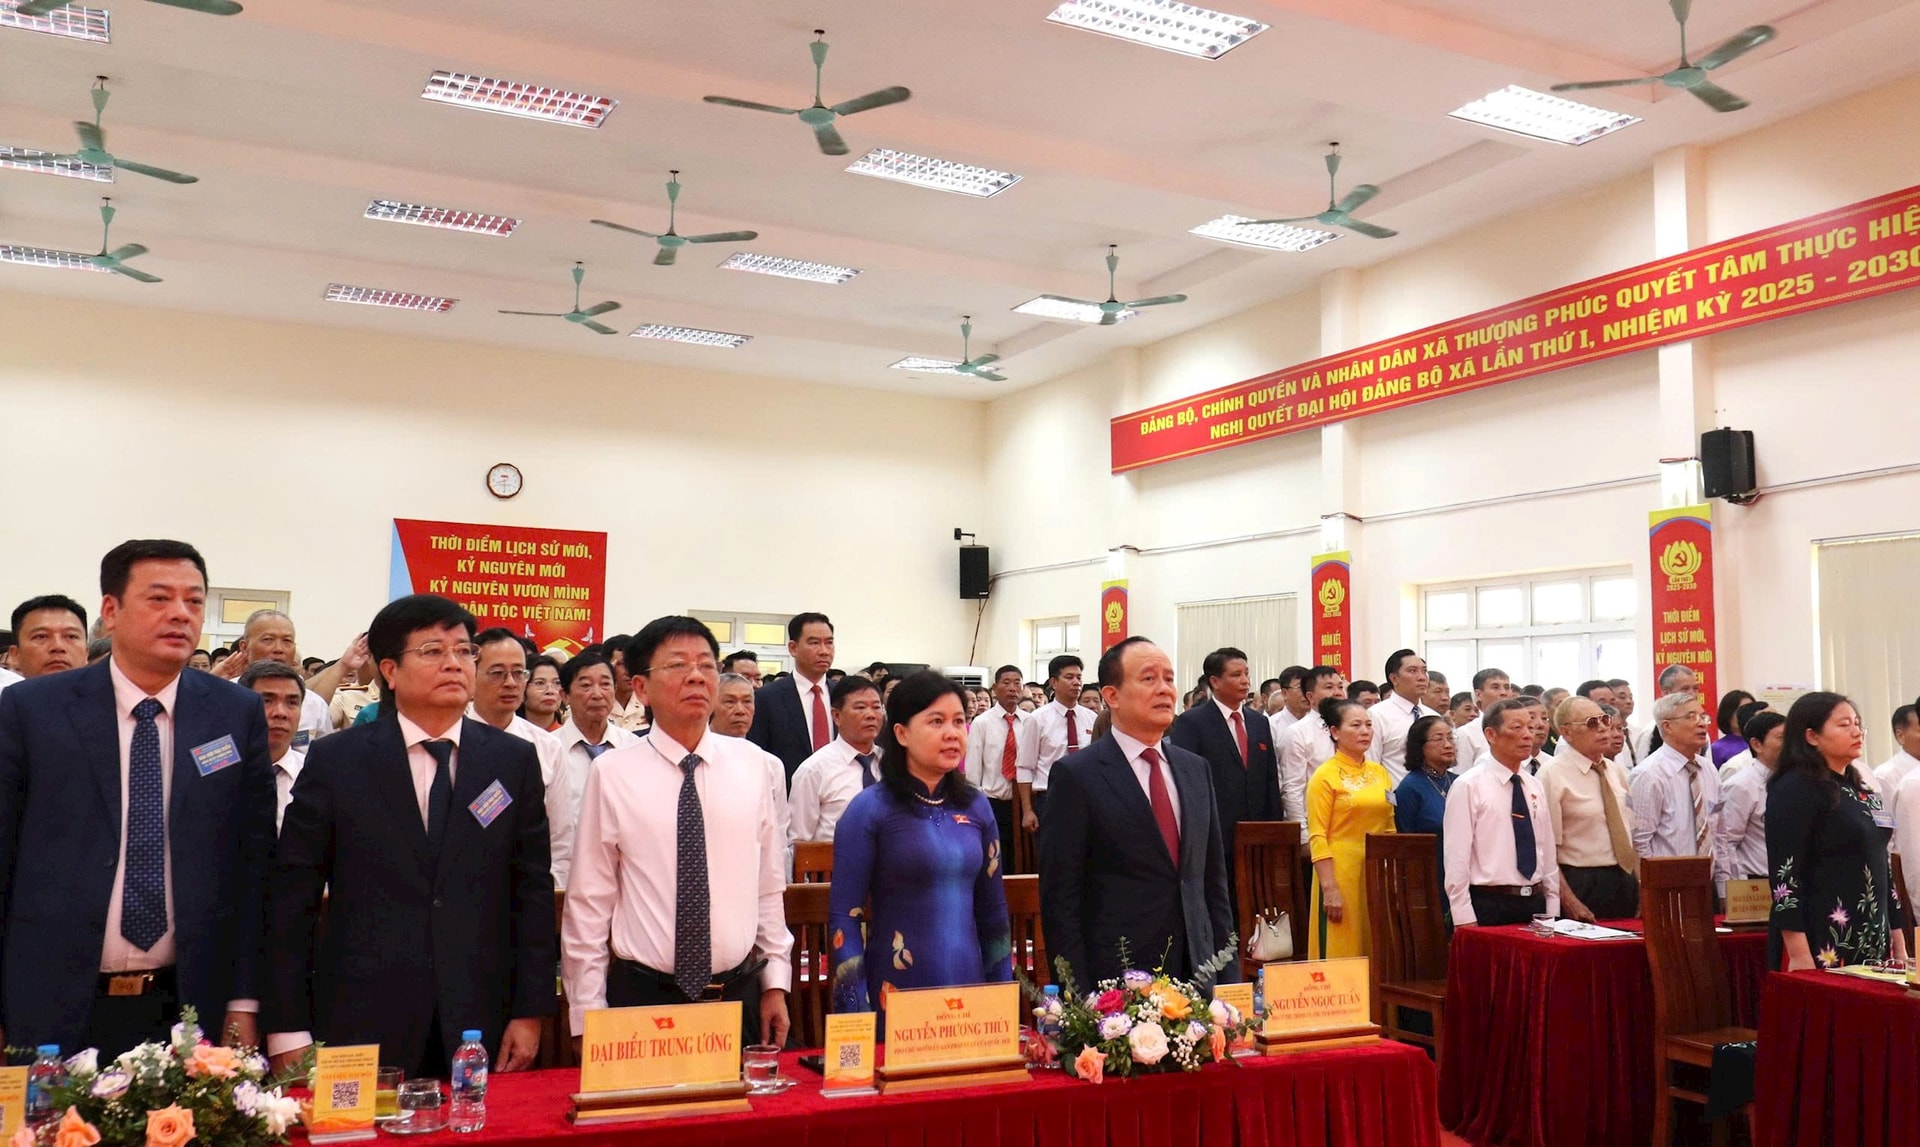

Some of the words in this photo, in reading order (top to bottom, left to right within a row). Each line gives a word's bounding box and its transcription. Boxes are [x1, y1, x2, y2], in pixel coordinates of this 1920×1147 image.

[1141, 411, 1173, 435] ĐẢNG
[1177, 410, 1198, 429] BỘ,
[1202, 395, 1244, 419] CHÍNH
[1248, 376, 1296, 407] QUYỀN
[1302, 369, 1322, 392] VÀ
[1327, 359, 1373, 385] NHÂN
[1380, 346, 1416, 373] DÂN
[1423, 334, 1448, 361] XÃ
[1454, 311, 1537, 345] THƯỢNG
[1545, 293, 1608, 326] PHÚC
[1616, 266, 1696, 307] QUYẾT
[1705, 256, 1766, 284] TÂM
[1776, 226, 1857, 263] THỰC
[1210, 417, 1243, 440] NGHỊ
[1248, 401, 1293, 430] QUYẾT
[1298, 397, 1324, 419] ĐẠI
[1329, 390, 1357, 411] HỘI
[1362, 378, 1410, 401] ĐẢNG
[1417, 365, 1442, 390] BỘ
[1449, 357, 1475, 381] XÃ
[1482, 345, 1523, 372] LẦN
[1531, 330, 1573, 361] THỨ
[1603, 305, 1688, 344] NHIỆM
[1697, 290, 1731, 318] KỲ
[1742, 273, 1814, 309] 2025
[430, 534, 462, 550] THỜI
[466, 534, 501, 552] ĐIỂM
[506, 541, 536, 556] LỊCH
[540, 540, 560, 556] SỬ
[563, 542, 592, 560] MỚI,
[457, 556, 475, 572] KỶ
[480, 560, 535, 577] NGUYÊN
[539, 563, 565, 578] MỚI
[430, 576, 448, 592] KỶ
[452, 580, 508, 597] NGUYÊN
[513, 583, 549, 598] VƯƠN
[553, 584, 589, 601] MÌNH
[492, 602, 518, 621] TỘC
[522, 604, 551, 622] VIỆT
[554, 607, 591, 621] NAM!
[1663, 608, 1679, 623] THỜI
[1681, 605, 1700, 623] ĐIỂM
[1660, 632, 1676, 647] LỊCH
[1678, 627, 1688, 643] SỬ
[1690, 627, 1706, 643] MỚI,
[1667, 649, 1696, 664] NGUYÊN
[1698, 648, 1712, 663] MỚI
[1272, 992, 1309, 1011] NGUYỄN
[1311, 994, 1337, 1010] NGỌC
[1339, 987, 1361, 1006] TUẤN
[894, 1021, 937, 1043] NGUYỄN
[939, 1022, 981, 1038] PHƯƠNG
[984, 1017, 1011, 1034] THỦY
[590, 1041, 613, 1067] ĐẠI
[616, 1031, 647, 1060] BIỂU
[649, 1036, 693, 1058] TRUNG
[697, 1032, 732, 1054] ƯƠNG
